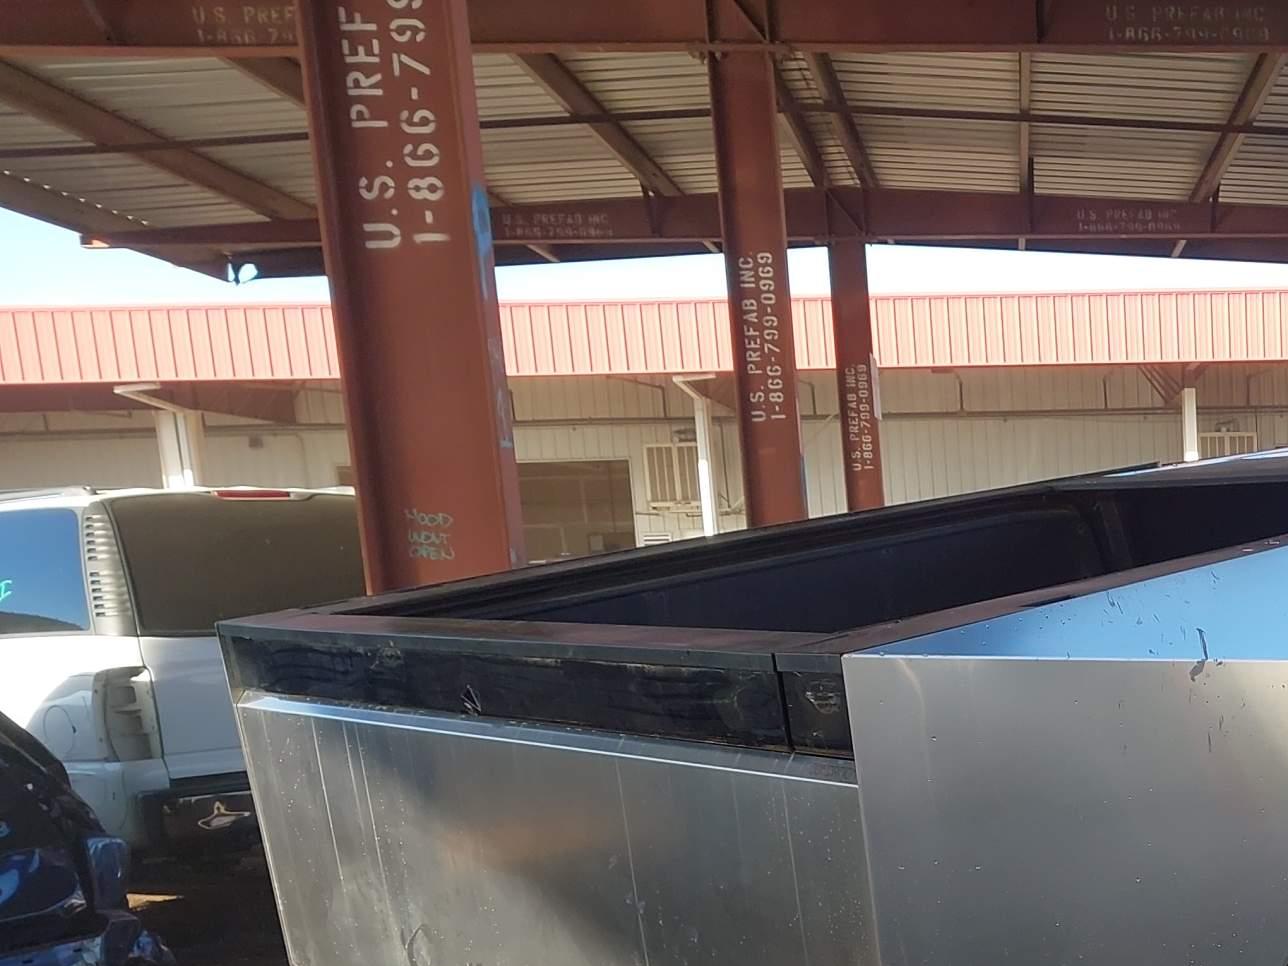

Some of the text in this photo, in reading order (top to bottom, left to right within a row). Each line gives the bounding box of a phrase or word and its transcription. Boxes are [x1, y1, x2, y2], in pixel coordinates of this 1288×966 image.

[359, 160, 402, 249] U.S.
[741, 299, 763, 374] PREFAB
[756, 252, 787, 420] 1-866-799-0969
[749, 385, 767, 422] U.S.
[846, 393, 860, 441] PREFAB
[856, 364, 875, 469] 1-866-799-0969
